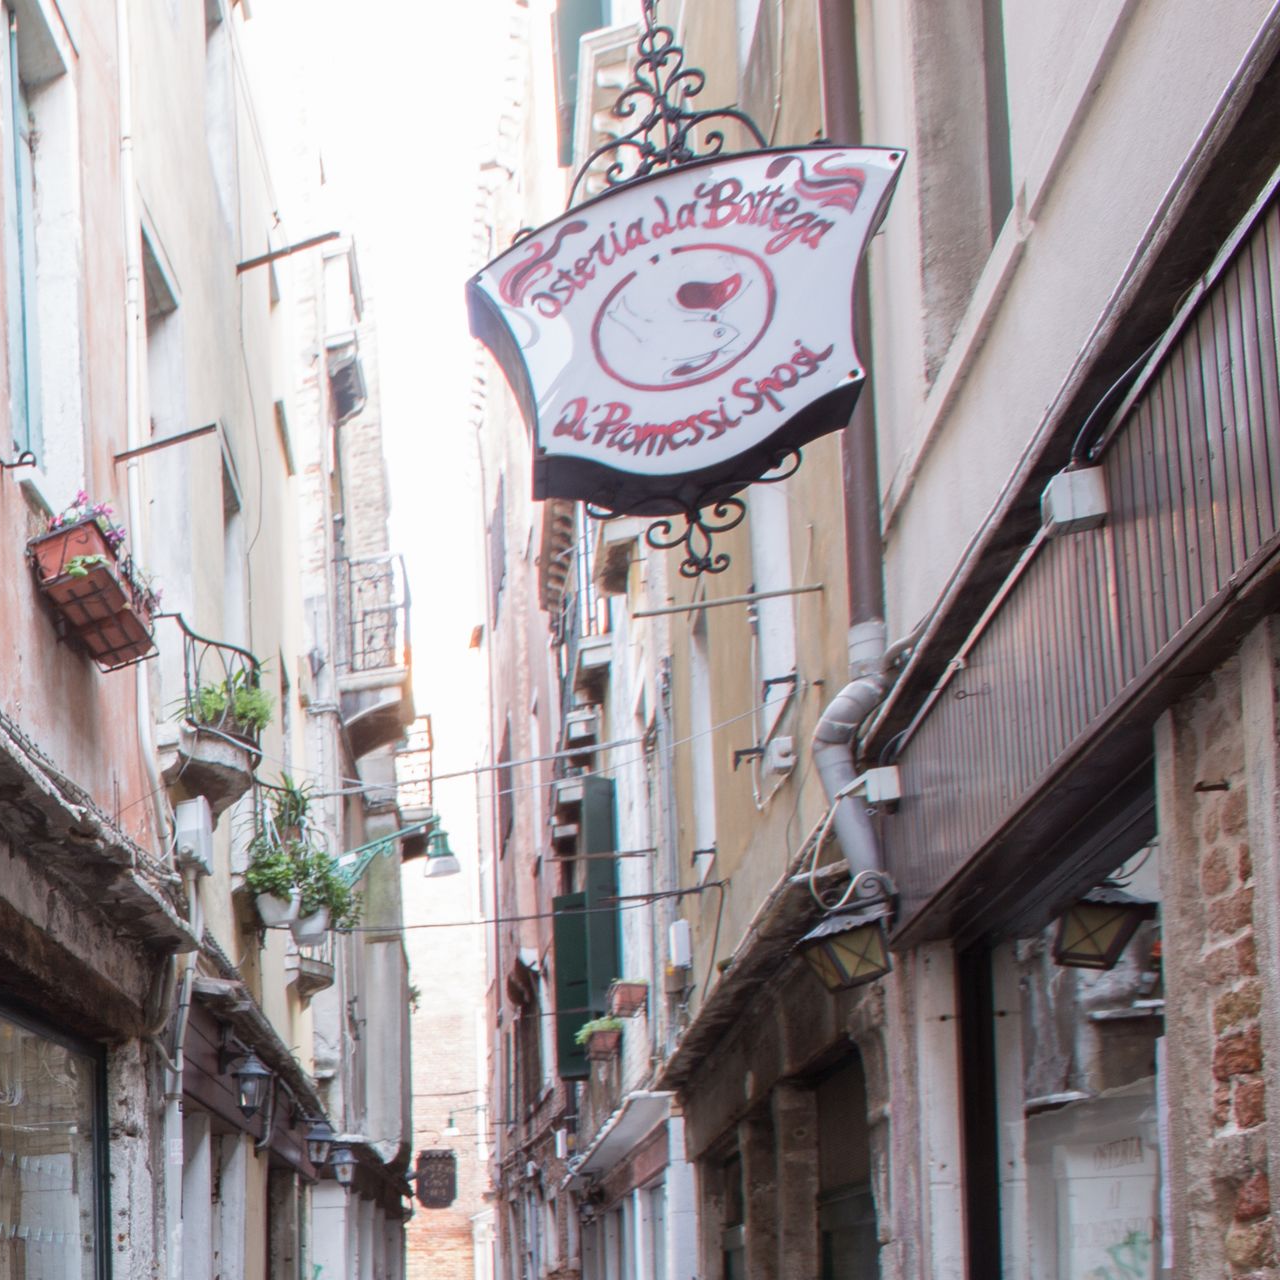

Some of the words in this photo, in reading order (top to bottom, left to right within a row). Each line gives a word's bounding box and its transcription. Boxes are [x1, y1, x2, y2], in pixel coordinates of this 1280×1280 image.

[694, 177, 836, 255] Bottega
[590, 396, 744, 456] Promessi
[731, 339, 835, 417] Sposi
